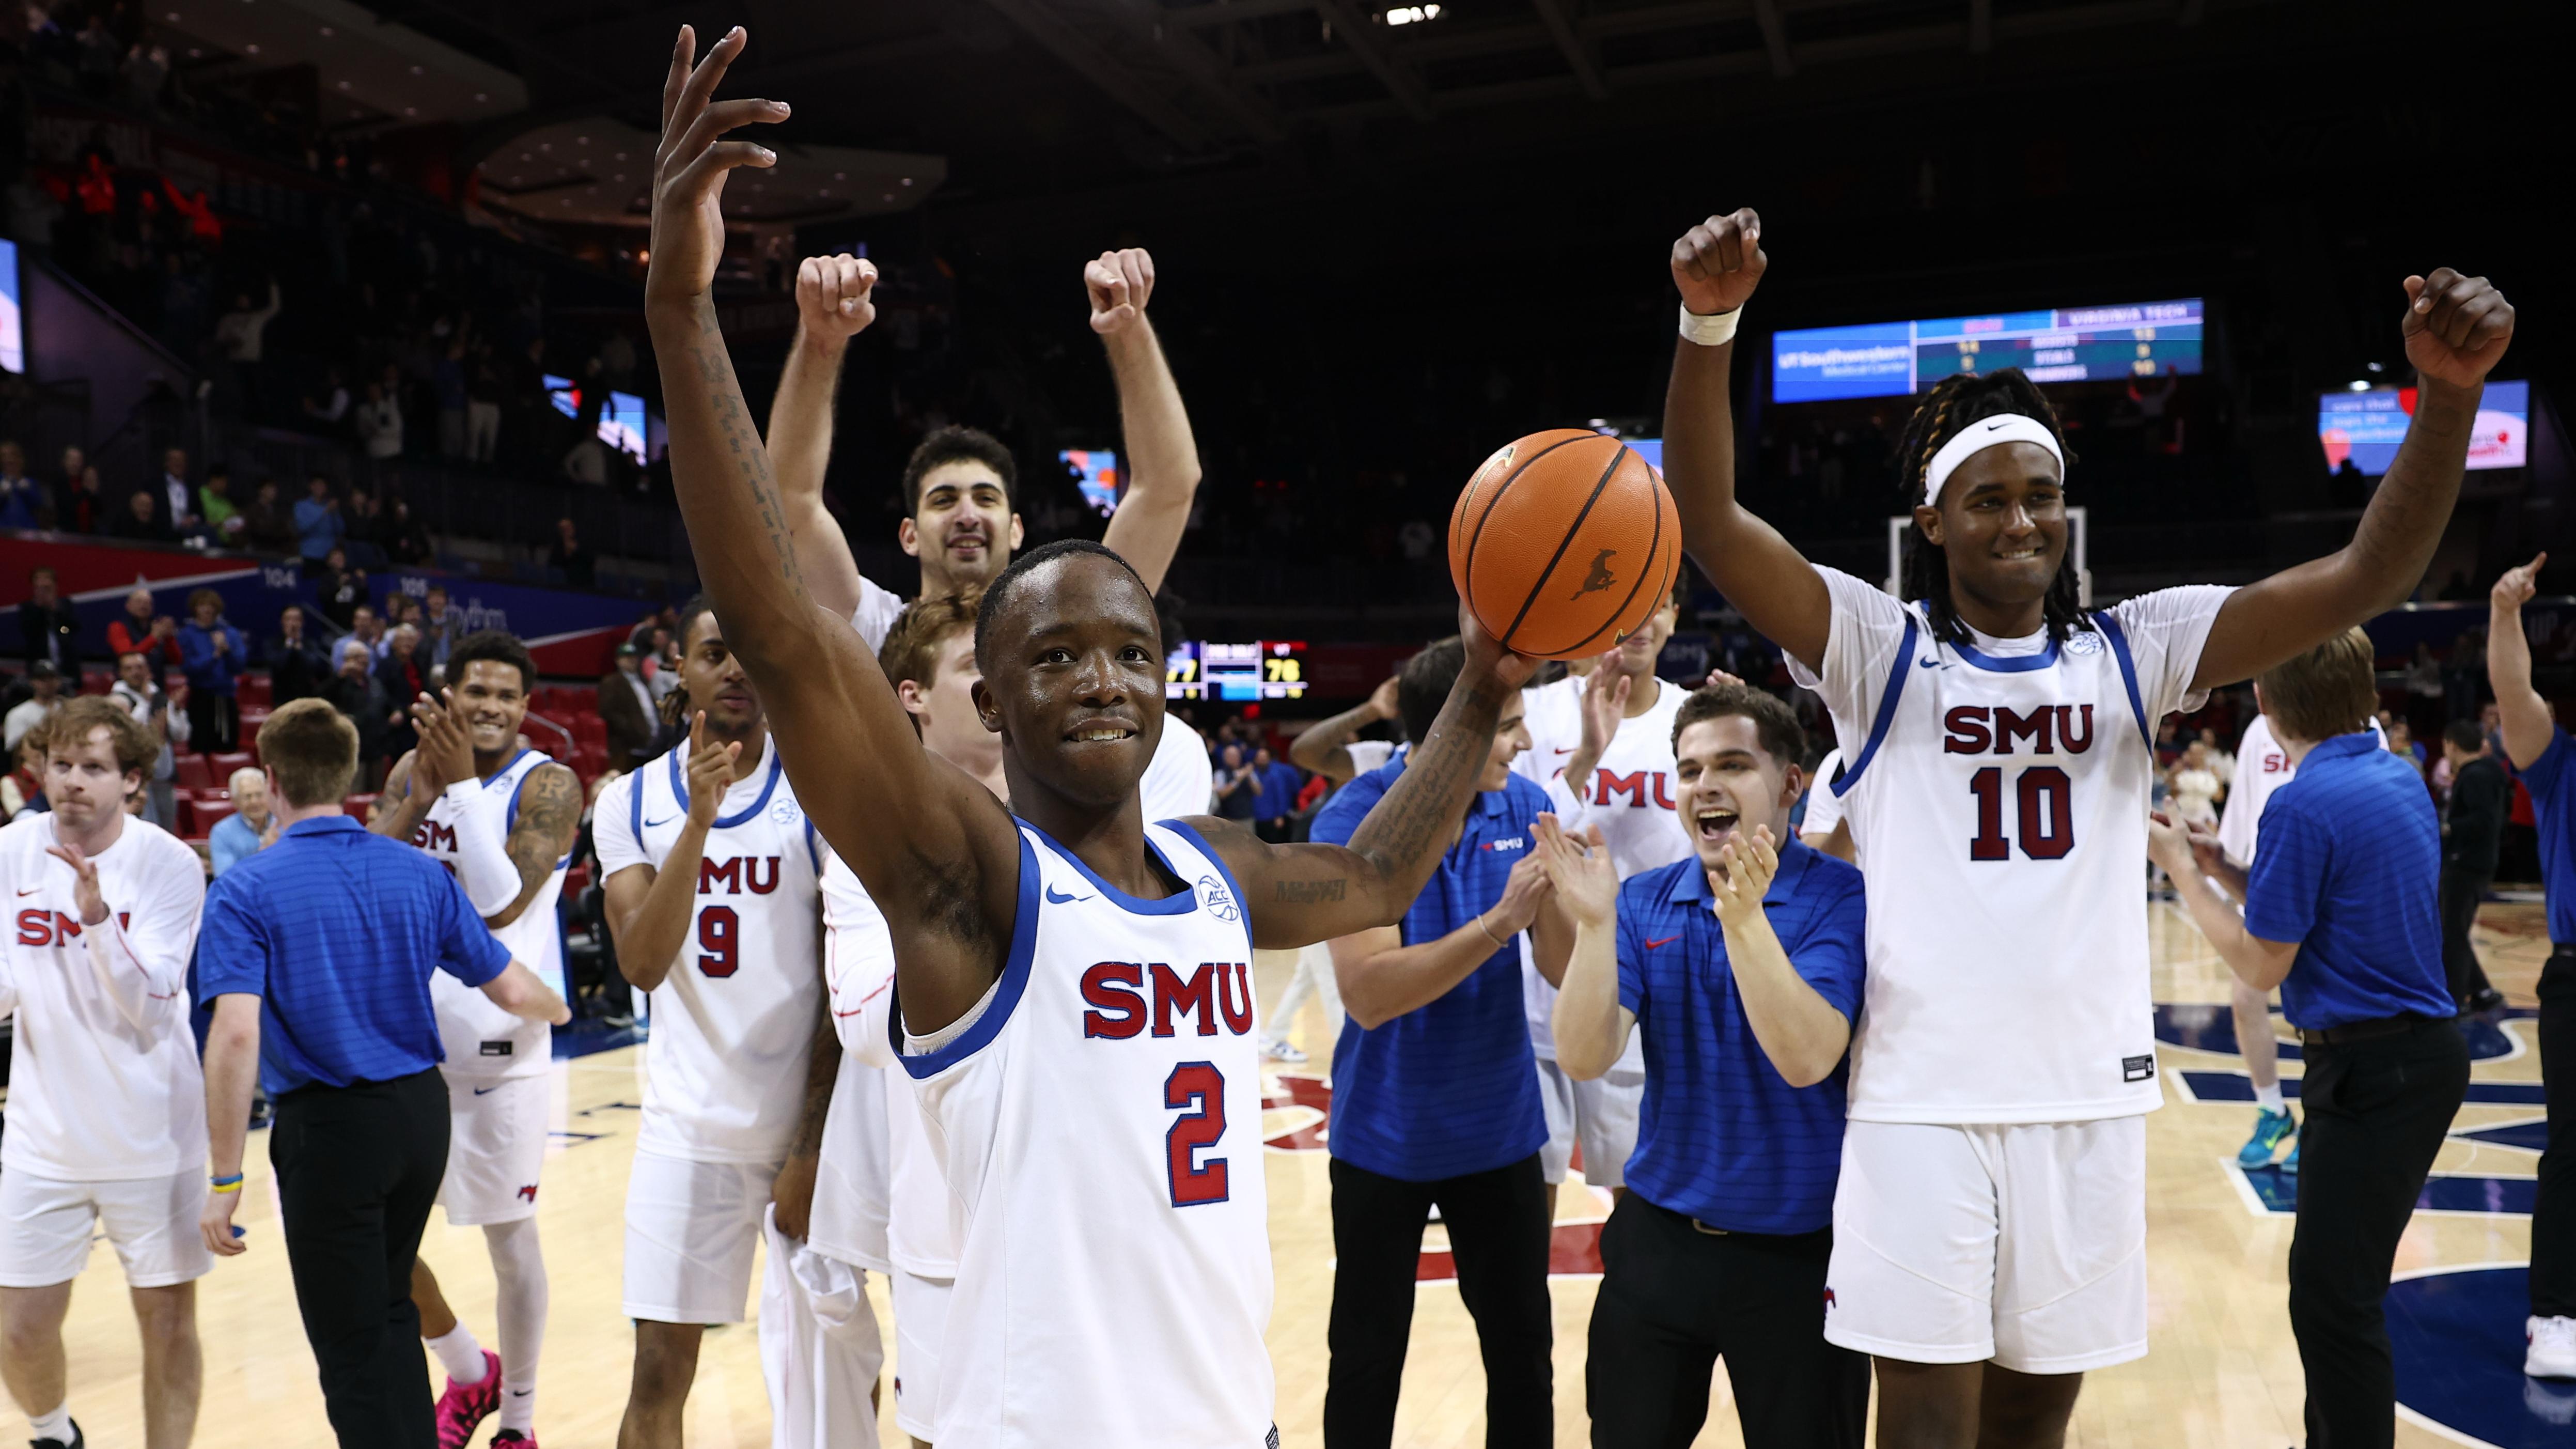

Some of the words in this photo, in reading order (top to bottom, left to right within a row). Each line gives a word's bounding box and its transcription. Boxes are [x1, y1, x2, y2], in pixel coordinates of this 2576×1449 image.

[1944, 704, 2094, 754] SMU
[1970, 766, 2074, 861] 10
[698, 856, 780, 894] MU
[1493, 837, 1523, 852] SMU
[1208, 890, 1228, 903] ACC
[698, 906, 738, 978] 9
[1080, 961, 1253, 1039] SMU
[1164, 1061, 1229, 1208] 2
